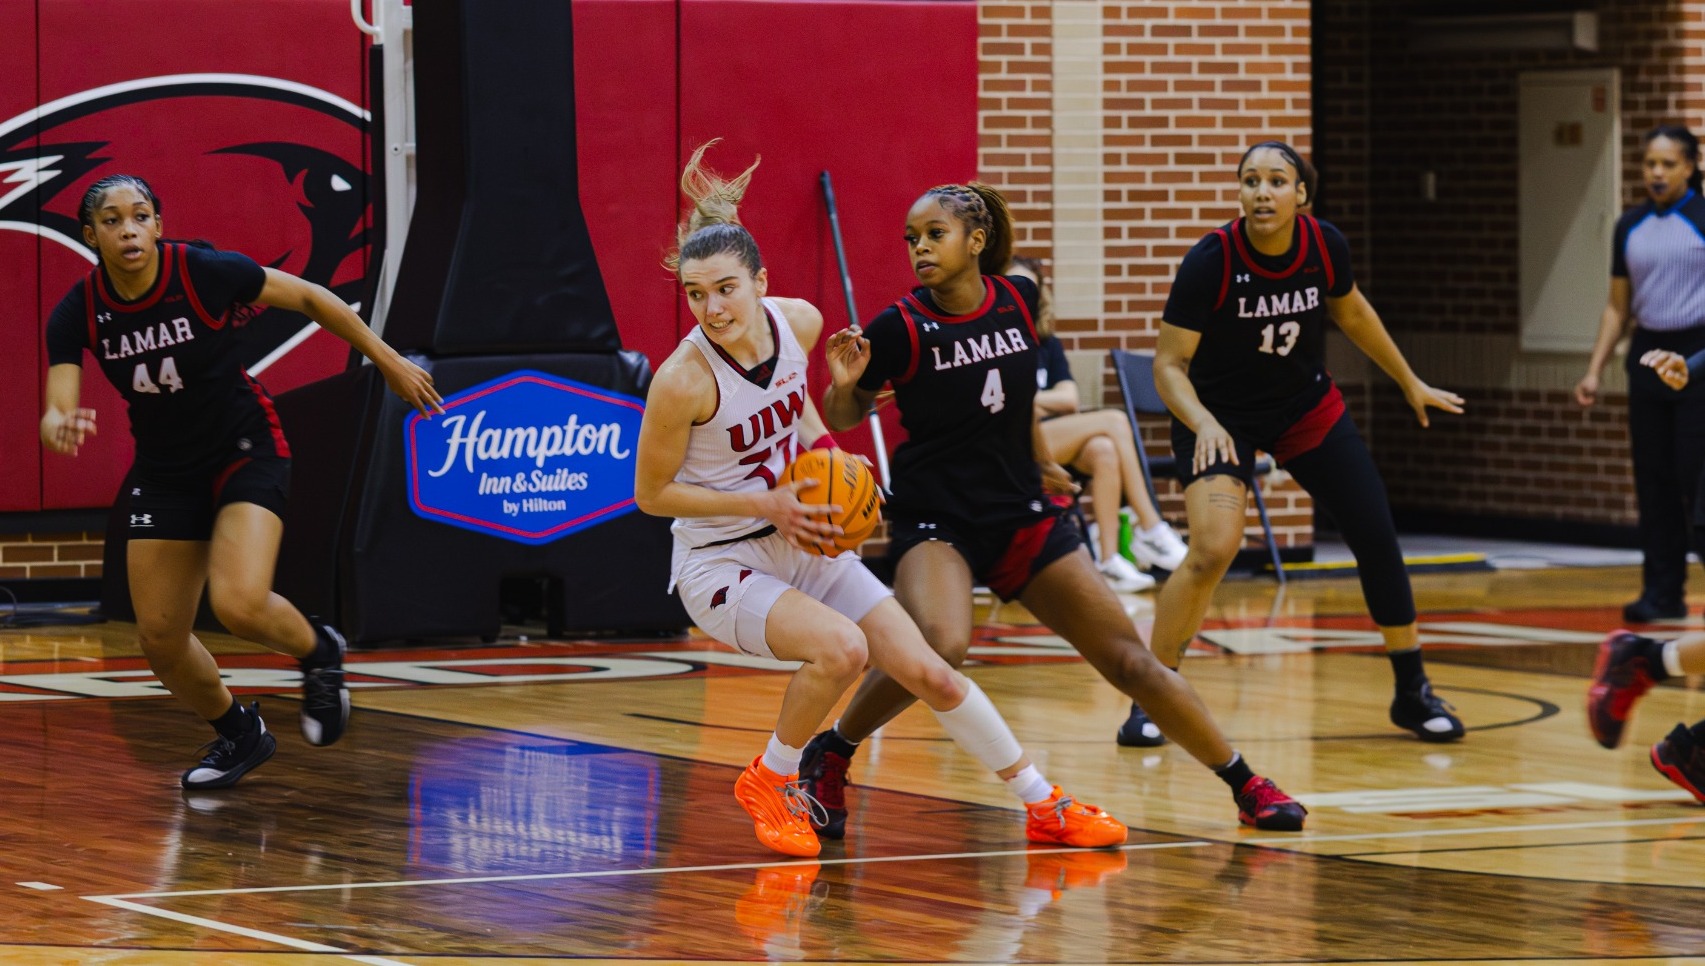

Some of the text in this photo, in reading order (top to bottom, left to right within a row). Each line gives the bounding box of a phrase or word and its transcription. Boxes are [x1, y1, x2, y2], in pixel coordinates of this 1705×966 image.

[1238, 286, 1319, 318] LAMAR
[102, 317, 195, 360] LAMAR
[931, 327, 1028, 371] LAMAR
[1258, 321, 1300, 357] 13
[132, 356, 184, 393] 44
[980, 368, 1005, 414] 4
[726, 384, 805, 452] UIW
[428, 410, 630, 477] Hampton
[503, 498, 566, 517] by Hilton
